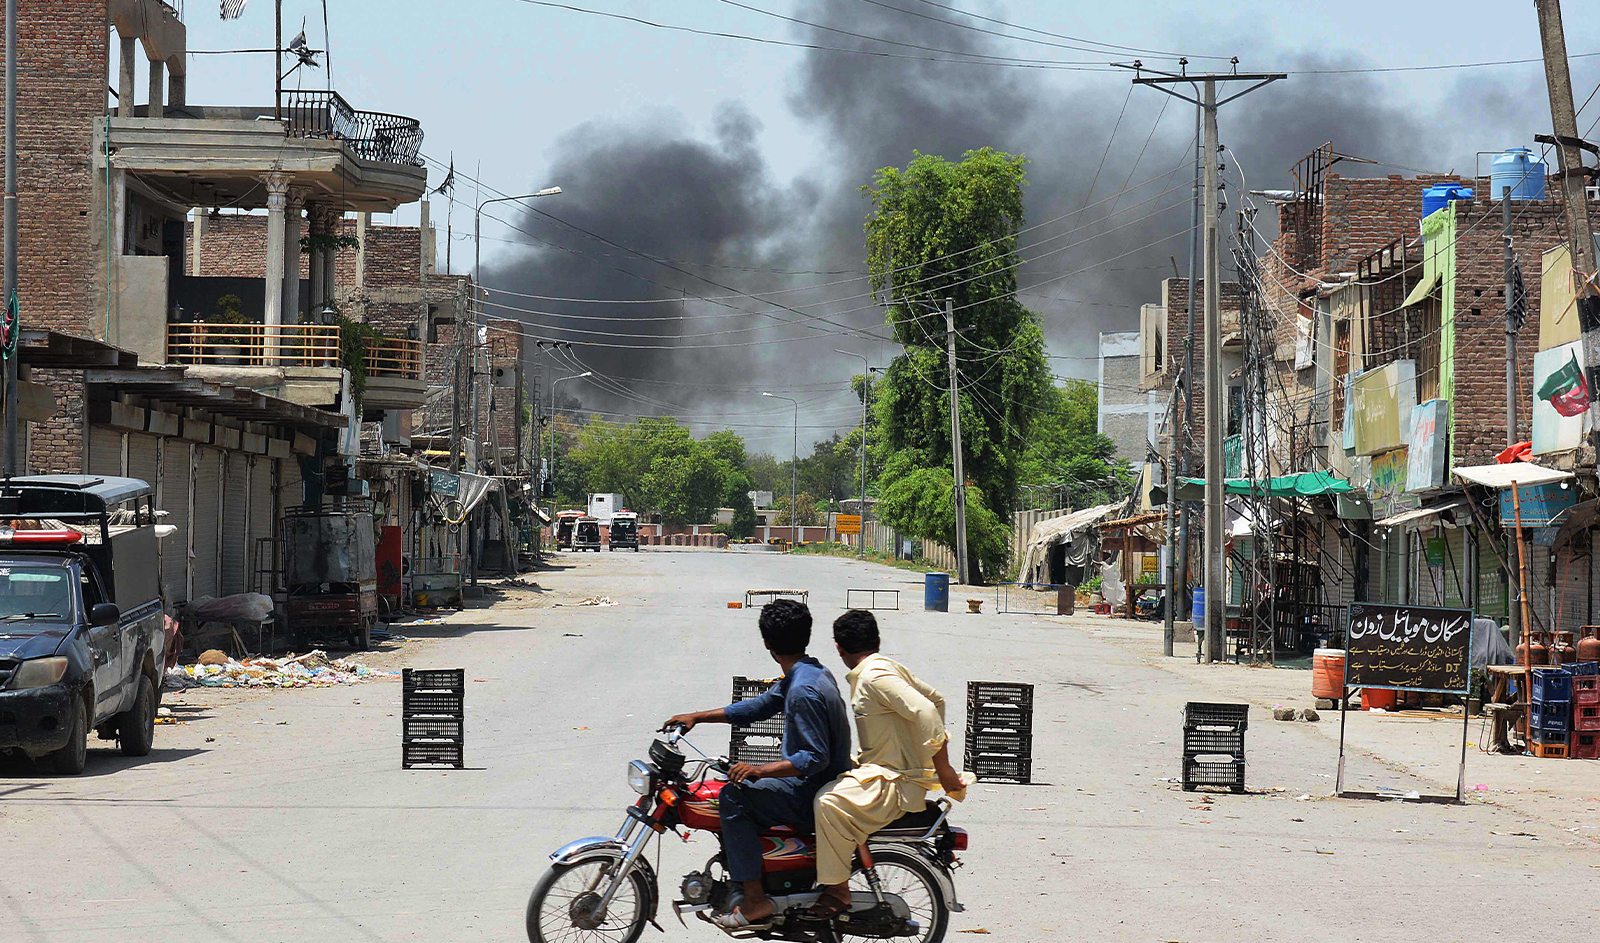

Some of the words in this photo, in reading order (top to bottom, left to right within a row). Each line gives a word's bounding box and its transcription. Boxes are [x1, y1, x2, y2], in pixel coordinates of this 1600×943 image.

[1350, 613, 1383, 639] زون
[1424, 615, 1470, 643] مسکان
[1349, 646, 1365, 656] ہے
[1367, 644, 1390, 656] دستیاب
[1351, 661, 1365, 671] ہے
[1369, 660, 1405, 672] دستیاب
[1445, 663, 1461, 673] DJ
